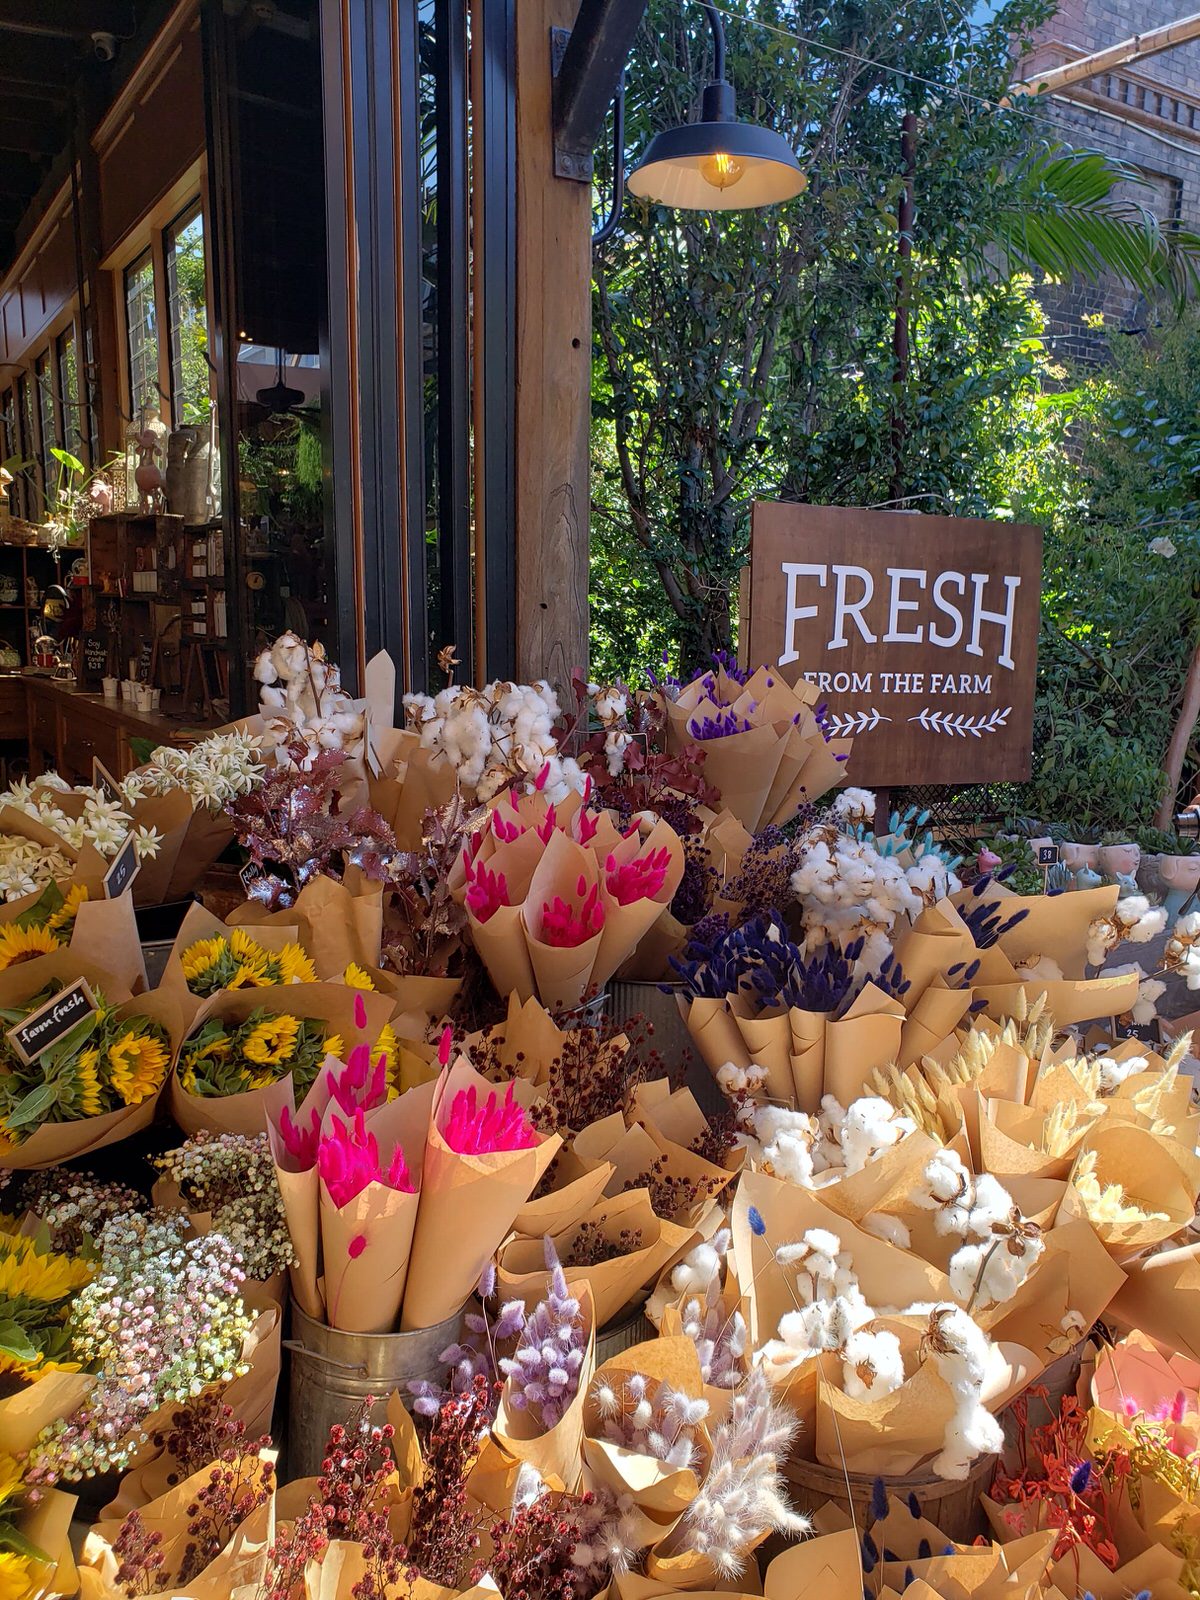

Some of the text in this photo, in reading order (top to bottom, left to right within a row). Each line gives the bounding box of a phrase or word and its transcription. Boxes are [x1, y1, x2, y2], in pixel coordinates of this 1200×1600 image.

[778, 562, 1022, 670] FRESH
[87, 638, 101, 650] Soy
[803, 671, 992, 694] FROM THE FARM
[1043, 849, 1052, 860] 38
[21, 993, 85, 1043] farm fresh
[1126, 1029, 1139, 1038] 25
